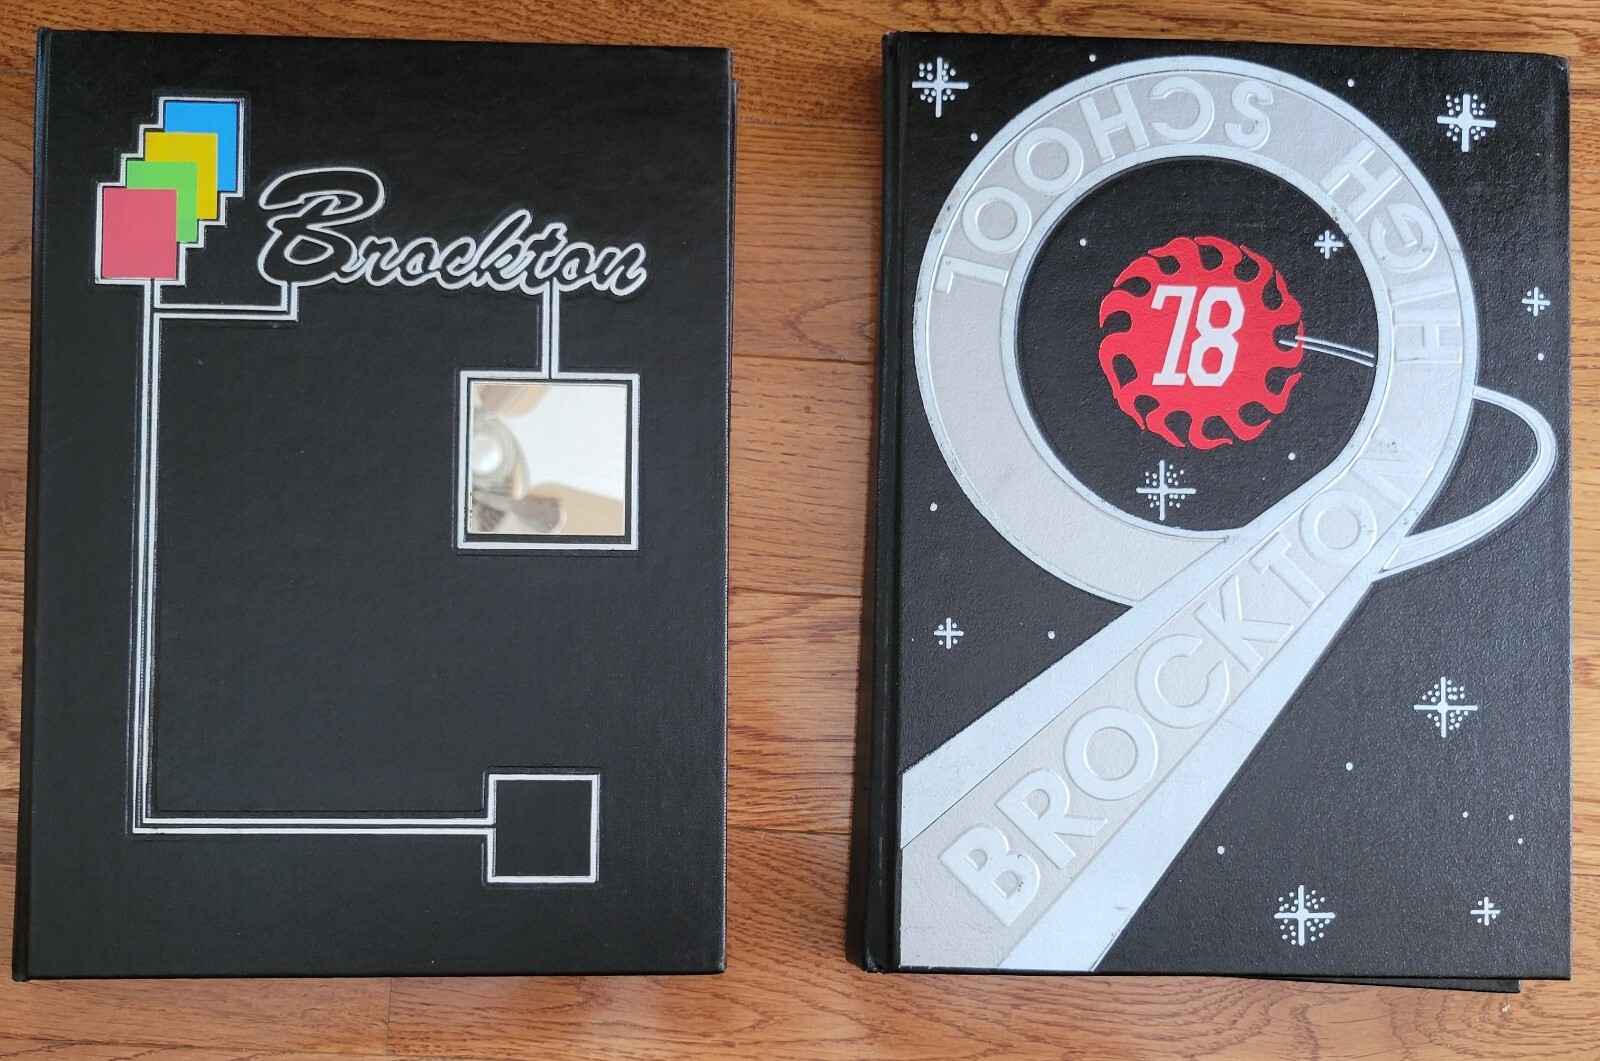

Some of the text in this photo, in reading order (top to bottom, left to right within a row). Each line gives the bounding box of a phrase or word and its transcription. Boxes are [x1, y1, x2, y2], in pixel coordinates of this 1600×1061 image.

[257, 166, 647, 296] Brockton
[1151, 285, 1245, 388] 78
[935, 77, 1463, 927] BROCKTON HIGH SCHOOL
